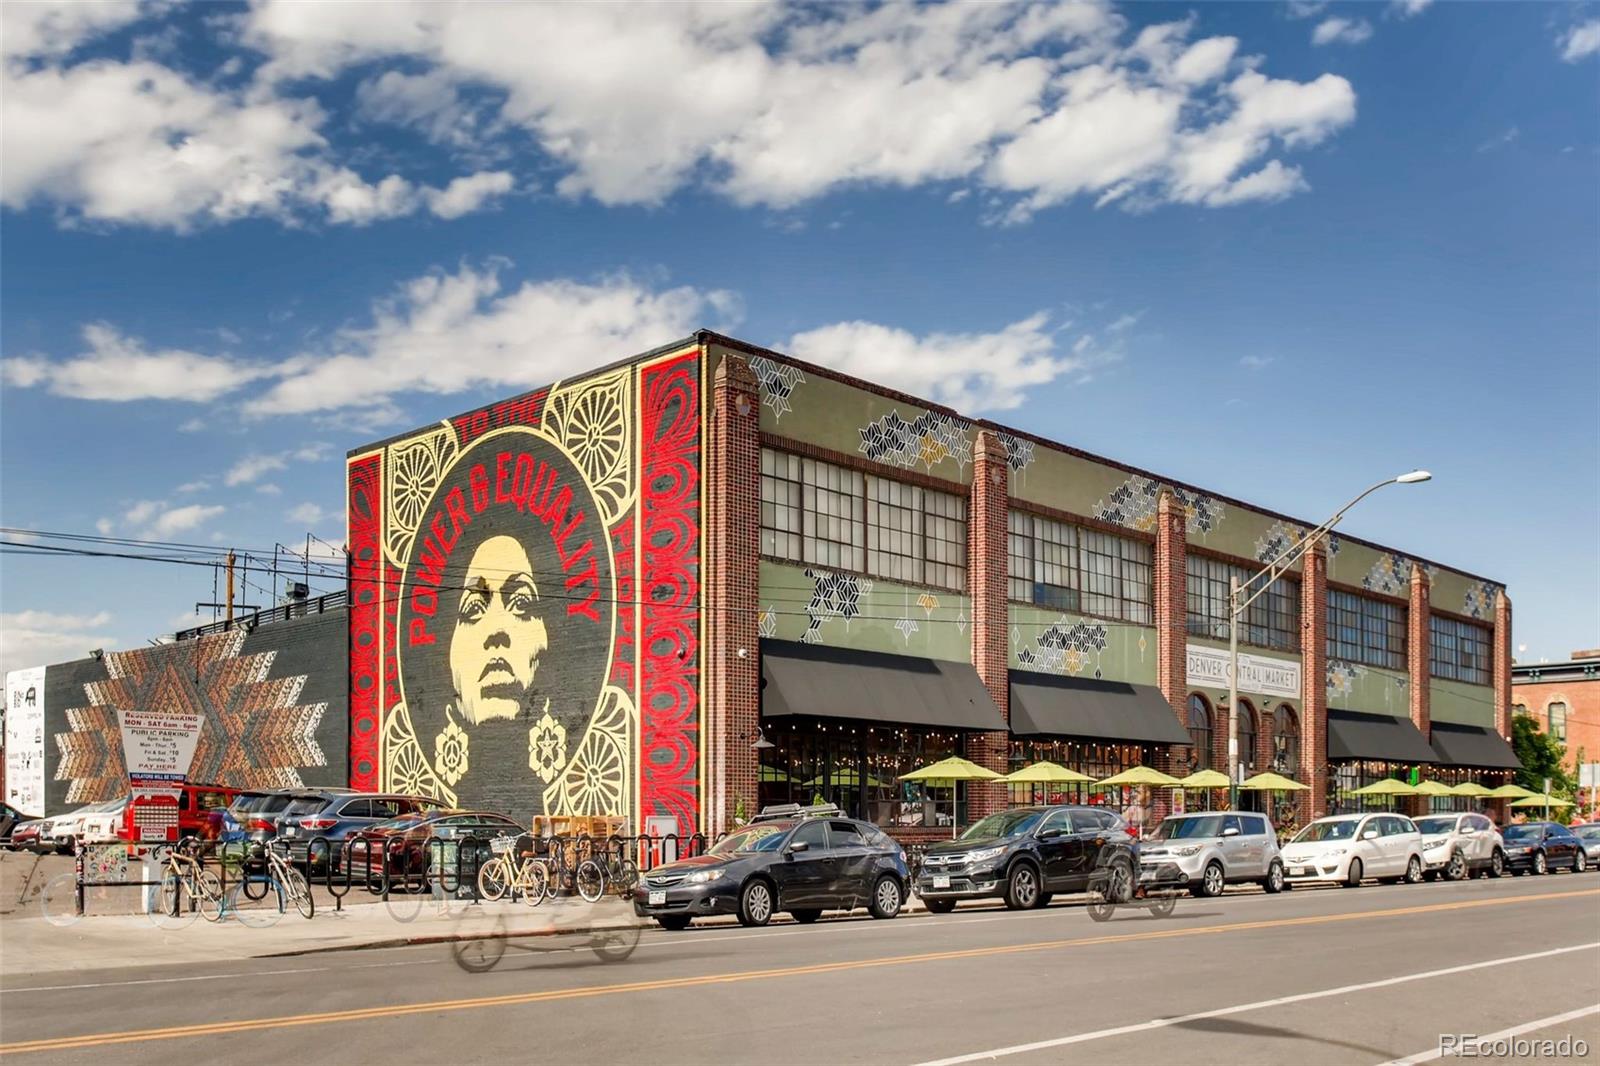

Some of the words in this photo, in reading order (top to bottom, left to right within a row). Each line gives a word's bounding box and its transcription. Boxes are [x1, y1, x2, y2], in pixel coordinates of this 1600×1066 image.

[454, 411, 489, 445] TO
[493, 388, 549, 426] THE
[409, 486, 471, 647] POWER
[496, 452, 601, 623] EQUALITY
[611, 516, 634, 690] PEOPLE
[385, 565, 401, 709] POWER
[1189, 657, 1222, 676] DENVER
[1265, 668, 1295, 688] MARKET
